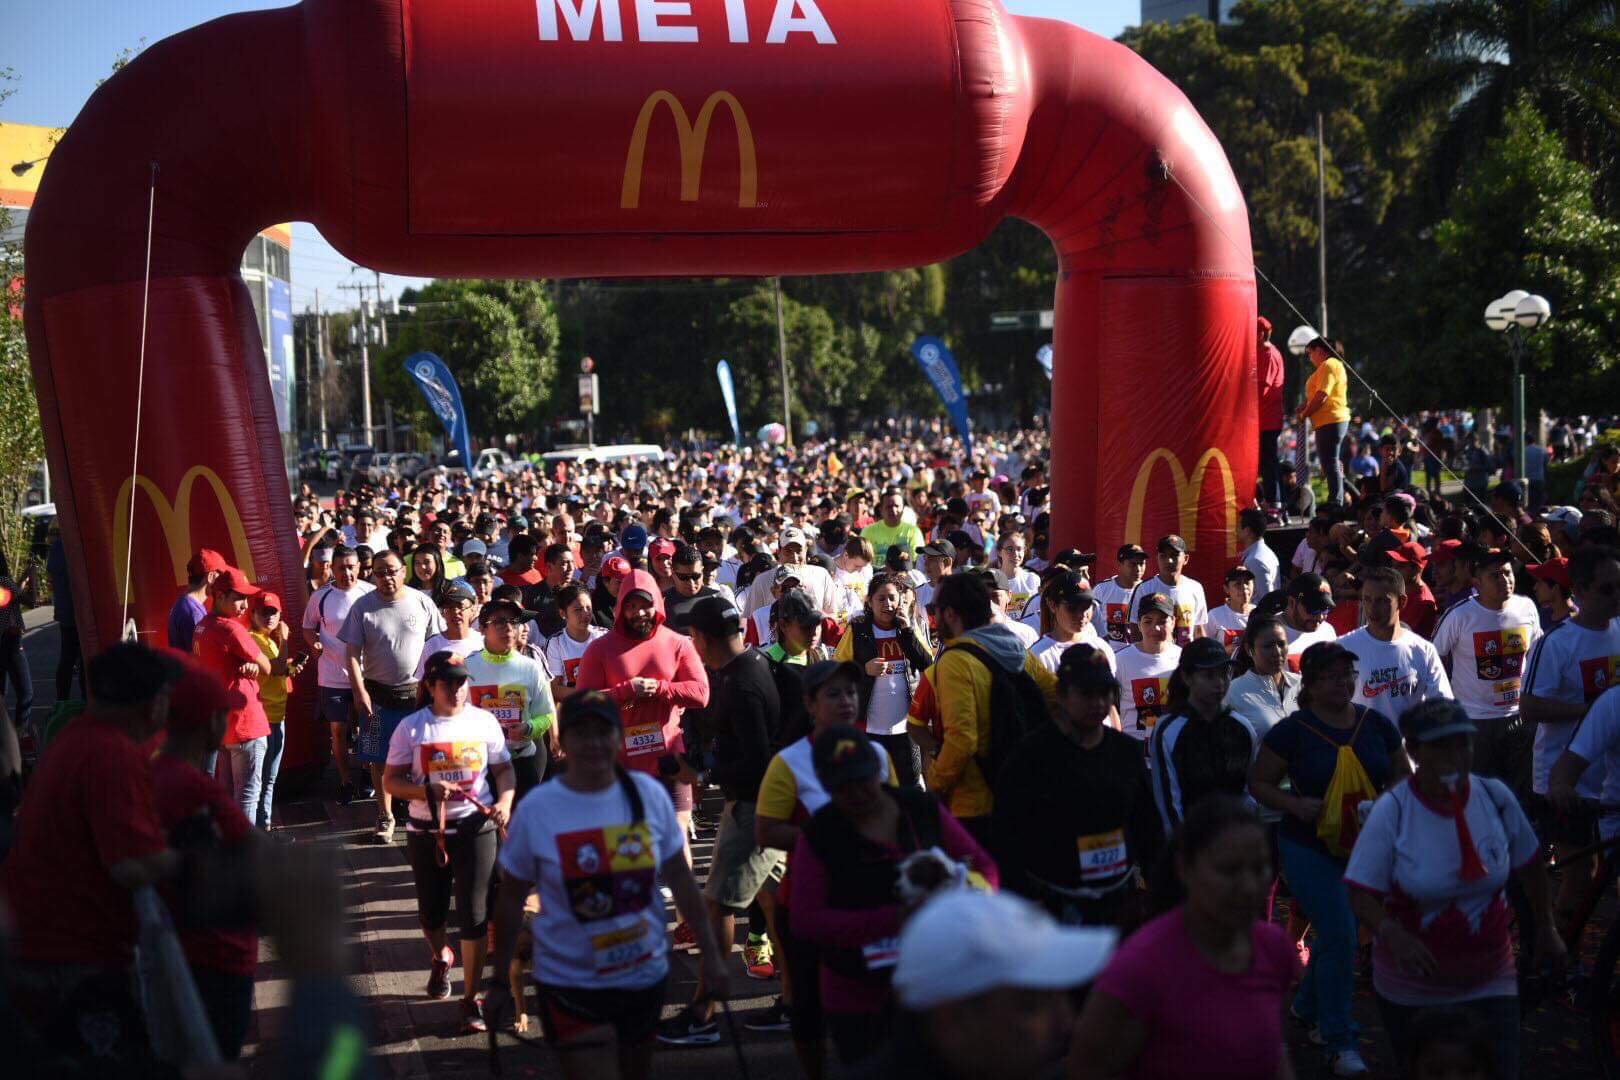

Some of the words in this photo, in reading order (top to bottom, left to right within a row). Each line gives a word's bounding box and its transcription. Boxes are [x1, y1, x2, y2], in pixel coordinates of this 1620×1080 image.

[535, 0, 838, 44] META
[1369, 666, 1399, 684] JUST
[632, 734, 656, 746] 4332
[439, 771, 464, 782] 3081
